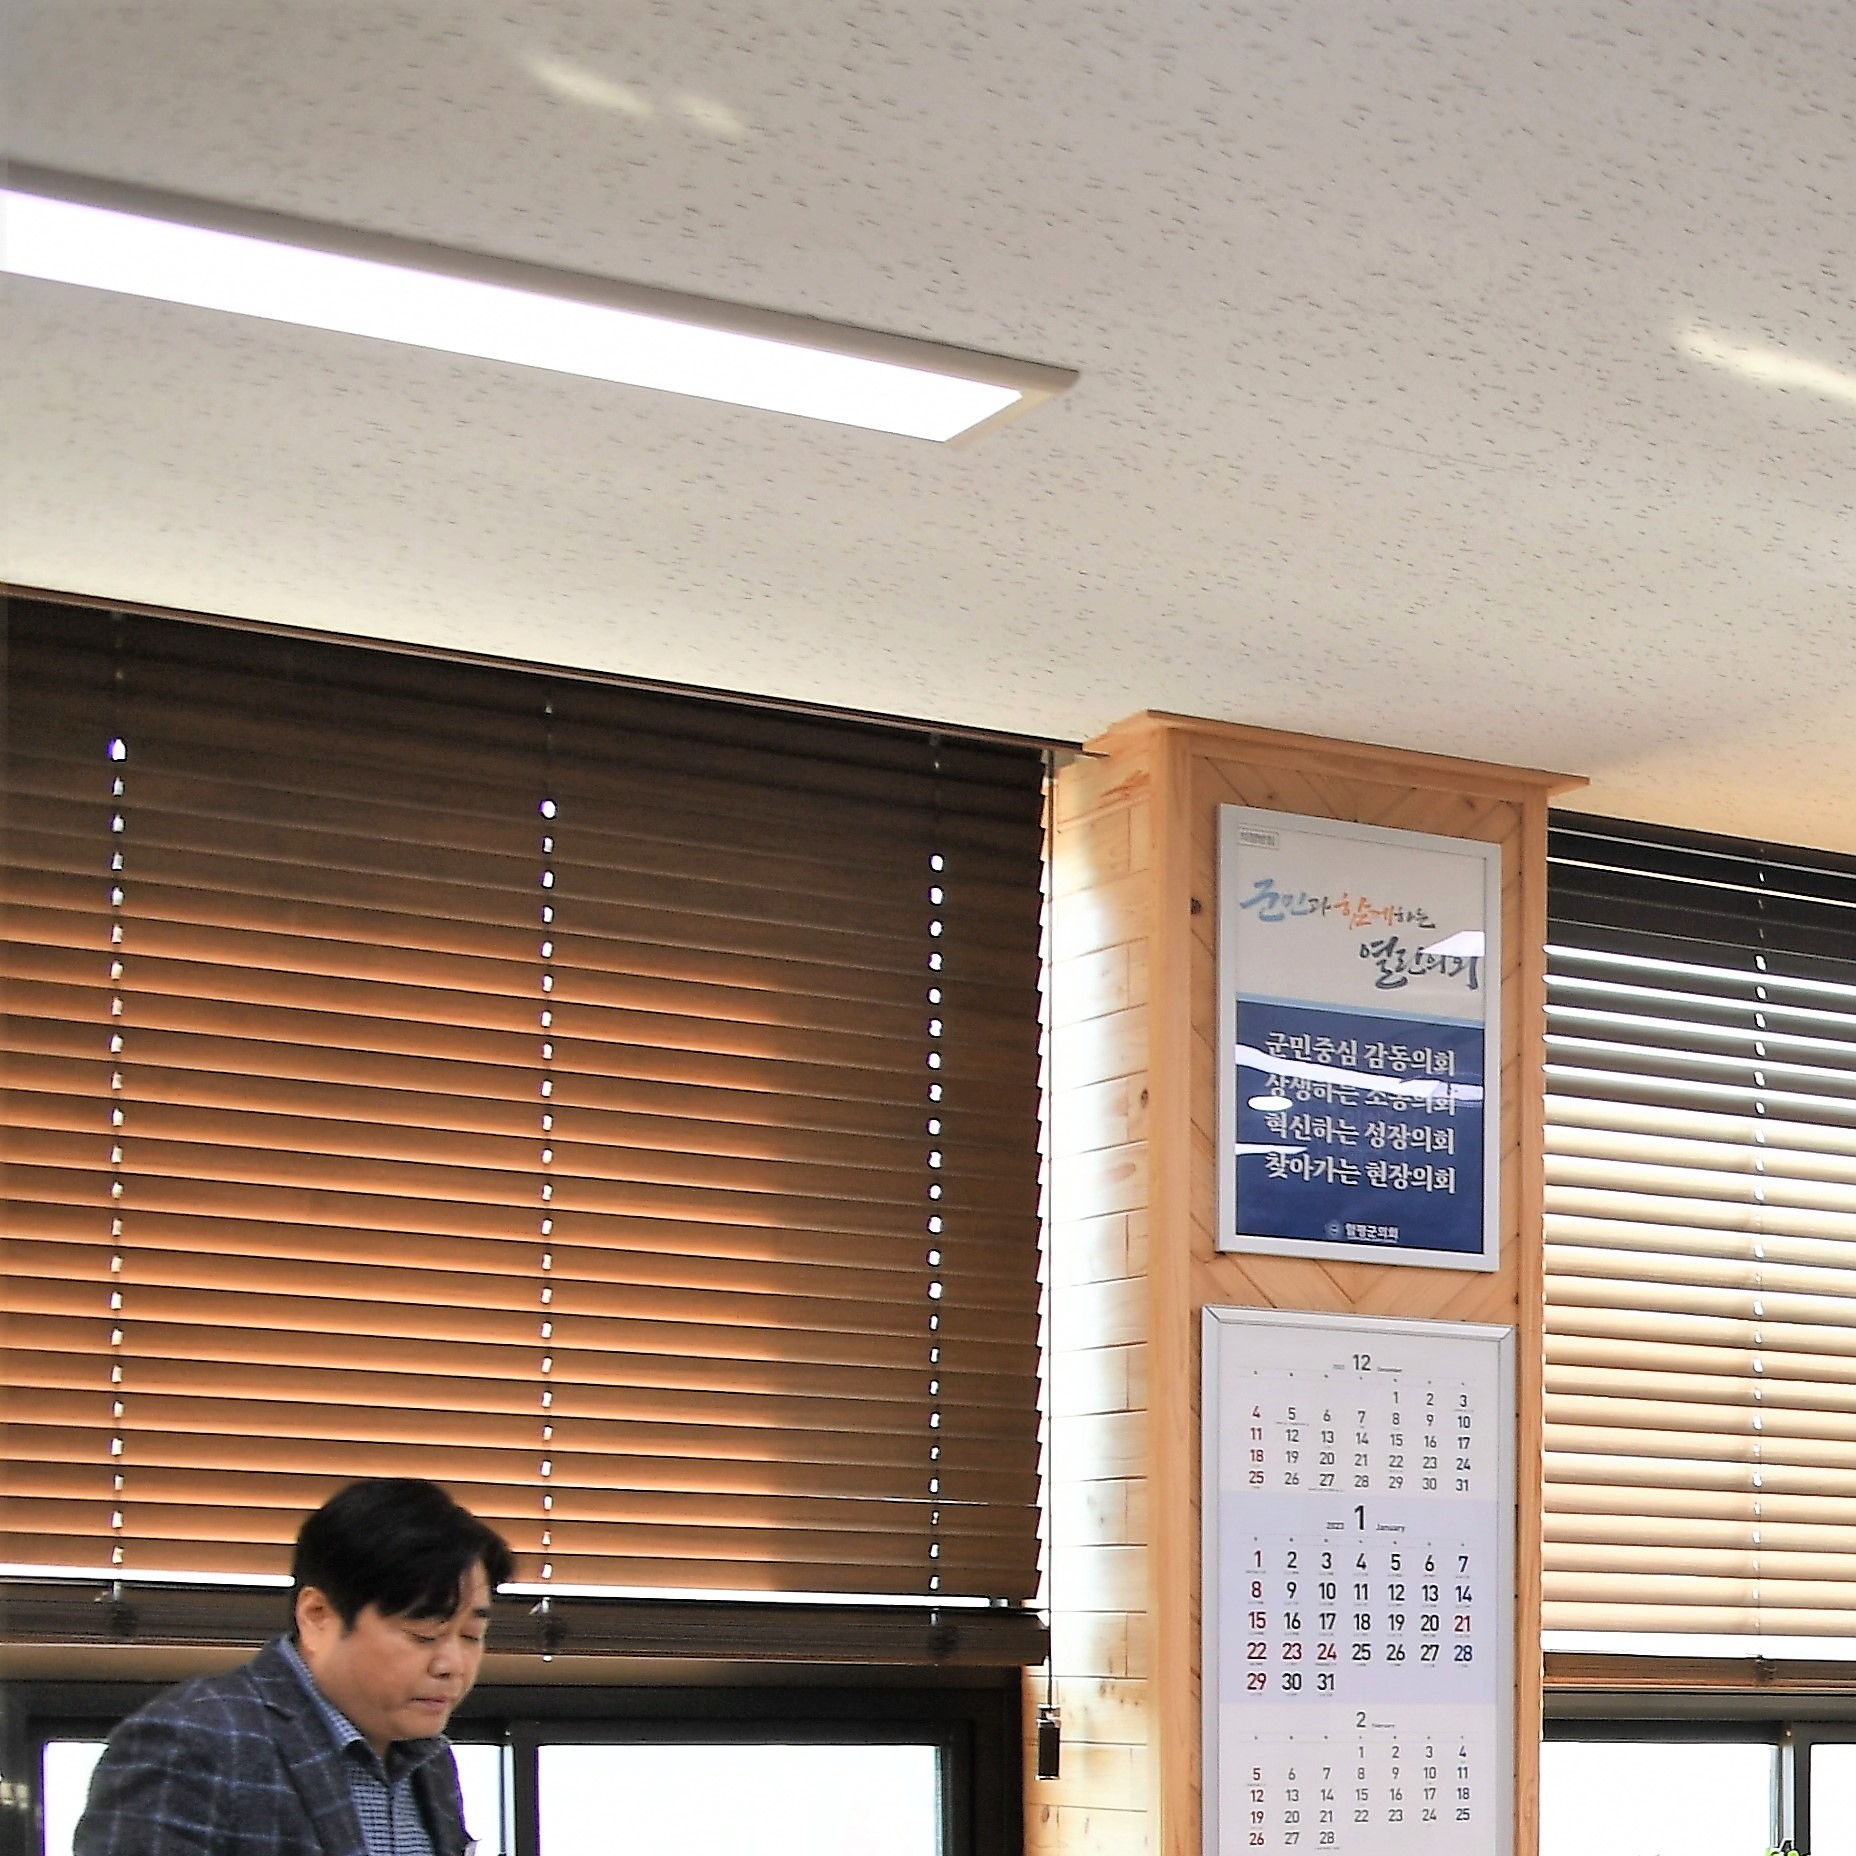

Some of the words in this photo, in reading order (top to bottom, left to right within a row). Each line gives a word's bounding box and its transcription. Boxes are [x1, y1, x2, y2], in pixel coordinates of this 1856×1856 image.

[1240, 878, 1331, 922] 군민과
[1265, 1031, 1358, 1066] 군민중심
[1364, 1042, 1456, 1077] 감동의회
[1264, 1111, 1360, 1146] 혁신하는
[1364, 1120, 1455, 1155] 성장의회
[1264, 1152, 1361, 1186] 찾아가는
[1364, 1160, 1456, 1194] 현장의회
[1352, 1354, 1372, 1372] 12
[1393, 1391, 1399, 1404] 1
[1426, 1392, 1434, 1406] 2
[1459, 1394, 1468, 1408] 3
[1252, 1405, 1261, 1419] 4
[1288, 1406, 1296, 1421] 5
[1323, 1409, 1331, 1422] 6
[1357, 1410, 1366, 1424] 7
[1392, 1412, 1400, 1426] 8
[1426, 1413, 1434, 1427] 9
[1457, 1415, 1471, 1429] 10
[1250, 1427, 1262, 1441] 11
[1285, 1428, 1300, 1443] 12
[1321, 1430, 1335, 1444] 13
[1355, 1432, 1369, 1445] 14
[1390, 1433, 1403, 1447] 15
[1423, 1435, 1437, 1449] 16
[1457, 1436, 1471, 1450] 17
[1250, 1449, 1264, 1463] 18
[1285, 1450, 1299, 1464] 19
[1319, 1451, 1335, 1465] 20
[1354, 1453, 1368, 1467] 21
[1388, 1454, 1404, 1469] 22
[1422, 1456, 1438, 1470] 23
[1456, 1457, 1471, 1471] 24
[1248, 1470, 1265, 1485] 25
[1284, 1471, 1300, 1486] 26
[1319, 1473, 1335, 1487] 27
[1354, 1474, 1370, 1488] 28
[1388, 1475, 1404, 1489] 29
[1422, 1477, 1437, 1491] 30
[1455, 1478, 1469, 1492] 31
[1354, 1505, 1365, 1531] 1
[1254, 1550, 1262, 1568] 1
[1287, 1551, 1298, 1569] 2
[1321, 1551, 1332, 1570] 3
[1355, 1552, 1367, 1570] 4
[1390, 1553, 1401, 1572] 5
[1424, 1554, 1435, 1572] 6
[1458, 1555, 1469, 1573] 7
[1251, 1580, 1262, 1599] 8
[1286, 1581, 1297, 1599] 9
[1318, 1582, 1336, 1600] 10
[1353, 1583, 1369, 1601] 11
[1387, 1583, 1406, 1602] 12
[1421, 1584, 1439, 1602] 13
[1455, 1585, 1473, 1603] 14
[1248, 1611, 1267, 1629] 15
[1283, 1611, 1301, 1630] 16
[1318, 1612, 1337, 1630] 17
[1353, 1613, 1371, 1631] 18
[1387, 1613, 1405, 1631] 19
[1420, 1614, 1440, 1632] 20
[1454, 1614, 1471, 1633] 21
[1246, 1641, 1268, 1660] 22
[1282, 1642, 1302, 1660] 23
[1316, 1642, 1338, 1661] 24
[1351, 1643, 1372, 1661] 25
[1386, 1643, 1406, 1661] 26
[1420, 1644, 1440, 1662] 27
[1453, 1644, 1473, 1662] 28
[1246, 1672, 1267, 1691] 29
[1281, 1672, 1302, 1691] 30
[1316, 1673, 1335, 1691] 31
[1356, 1711, 1367, 1728] 2
[1358, 1745, 1364, 1759] 1
[1391, 1745, 1400, 1759] 2
[1425, 1745, 1433, 1759] 3
[1458, 1745, 1467, 1758] 4
[1253, 1767, 1261, 1781] 5
[1288, 1767, 1296, 1781] 6
[1322, 1767, 1331, 1780] 7
[1357, 1767, 1366, 1780] 8
[1391, 1766, 1400, 1780] 9
[1423, 1766, 1437, 1780] 10
[1457, 1766, 1468, 1780] 11
[1250, 1789, 1264, 1803] 12
[1285, 1788, 1300, 1802] 13
[1320, 1788, 1335, 1802] 14
[1355, 1788, 1369, 1801] 15
[1389, 1787, 1403, 1801] 16
[1423, 1787, 1437, 1800] 17
[1457, 1787, 1470, 1800] 18
[1250, 1810, 1265, 1824] 19
[1284, 1810, 1300, 1824] 20
[1319, 1809, 1333, 1823] 21
[1354, 1809, 1369, 1823] 22
[1388, 1808, 1403, 1822] 23
[1422, 1808, 1437, 1822] 24
[1455, 1807, 1470, 1821] 25
[1249, 1832, 1265, 1846] 26
[1284, 1831, 1300, 1845] 27
[1319, 1831, 1335, 1845] 28
